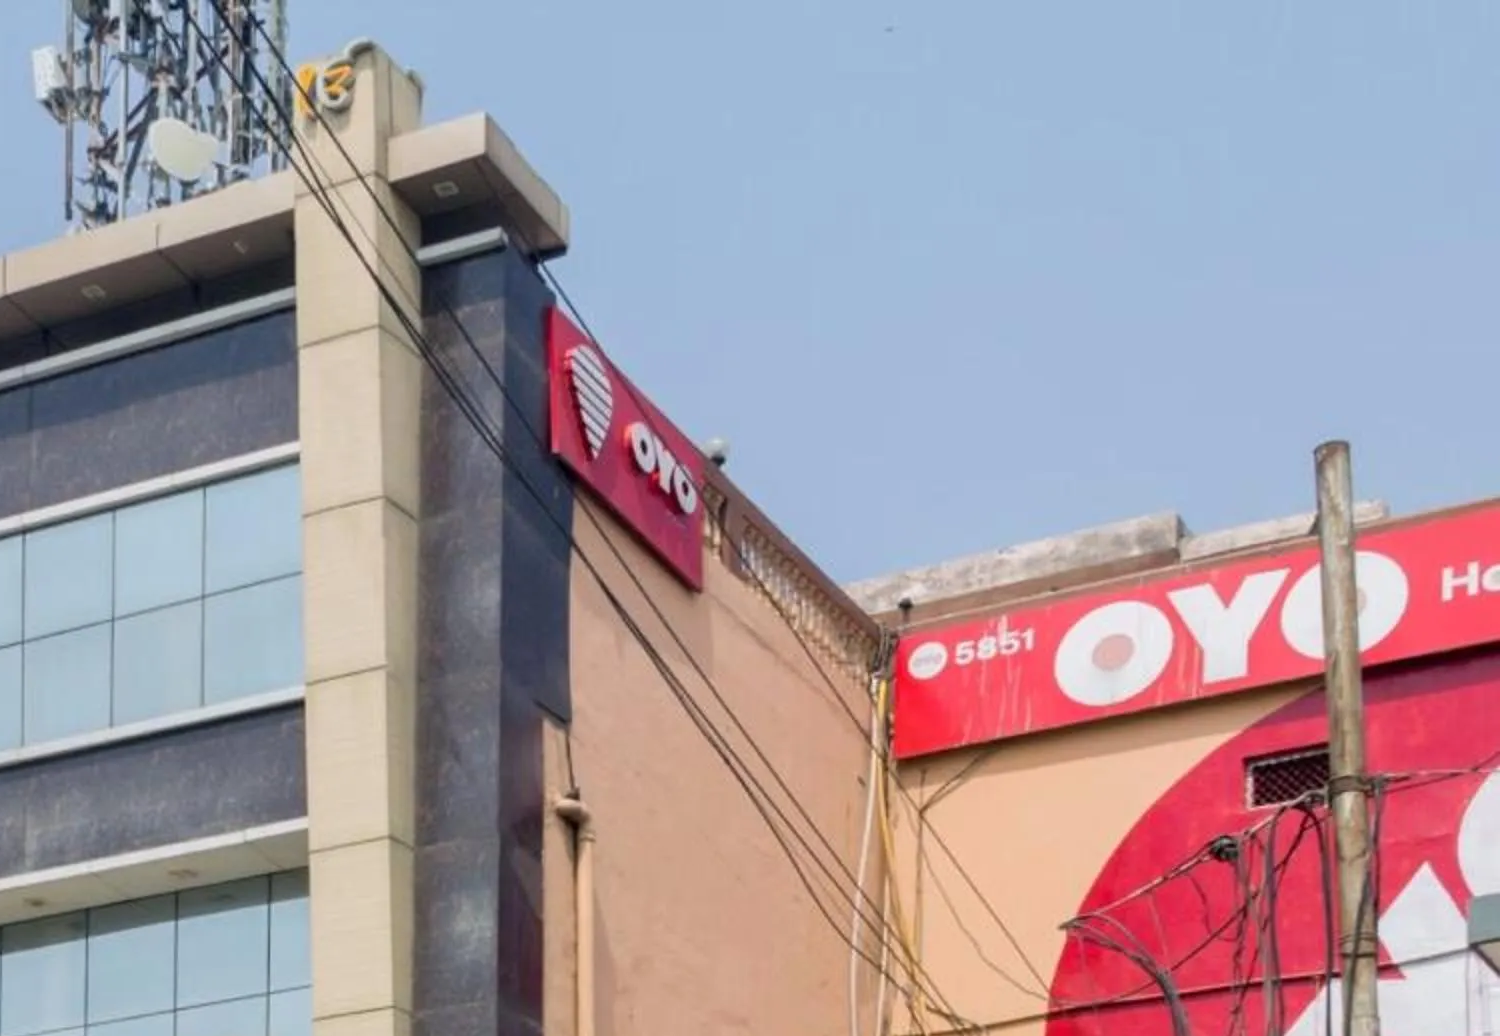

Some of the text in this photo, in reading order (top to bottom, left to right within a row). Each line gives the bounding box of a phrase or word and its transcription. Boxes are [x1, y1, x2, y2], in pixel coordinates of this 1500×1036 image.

[630, 421, 698, 515] OYO
[955, 626, 1035, 666] 5851
[1054, 550, 1410, 706] OYO
